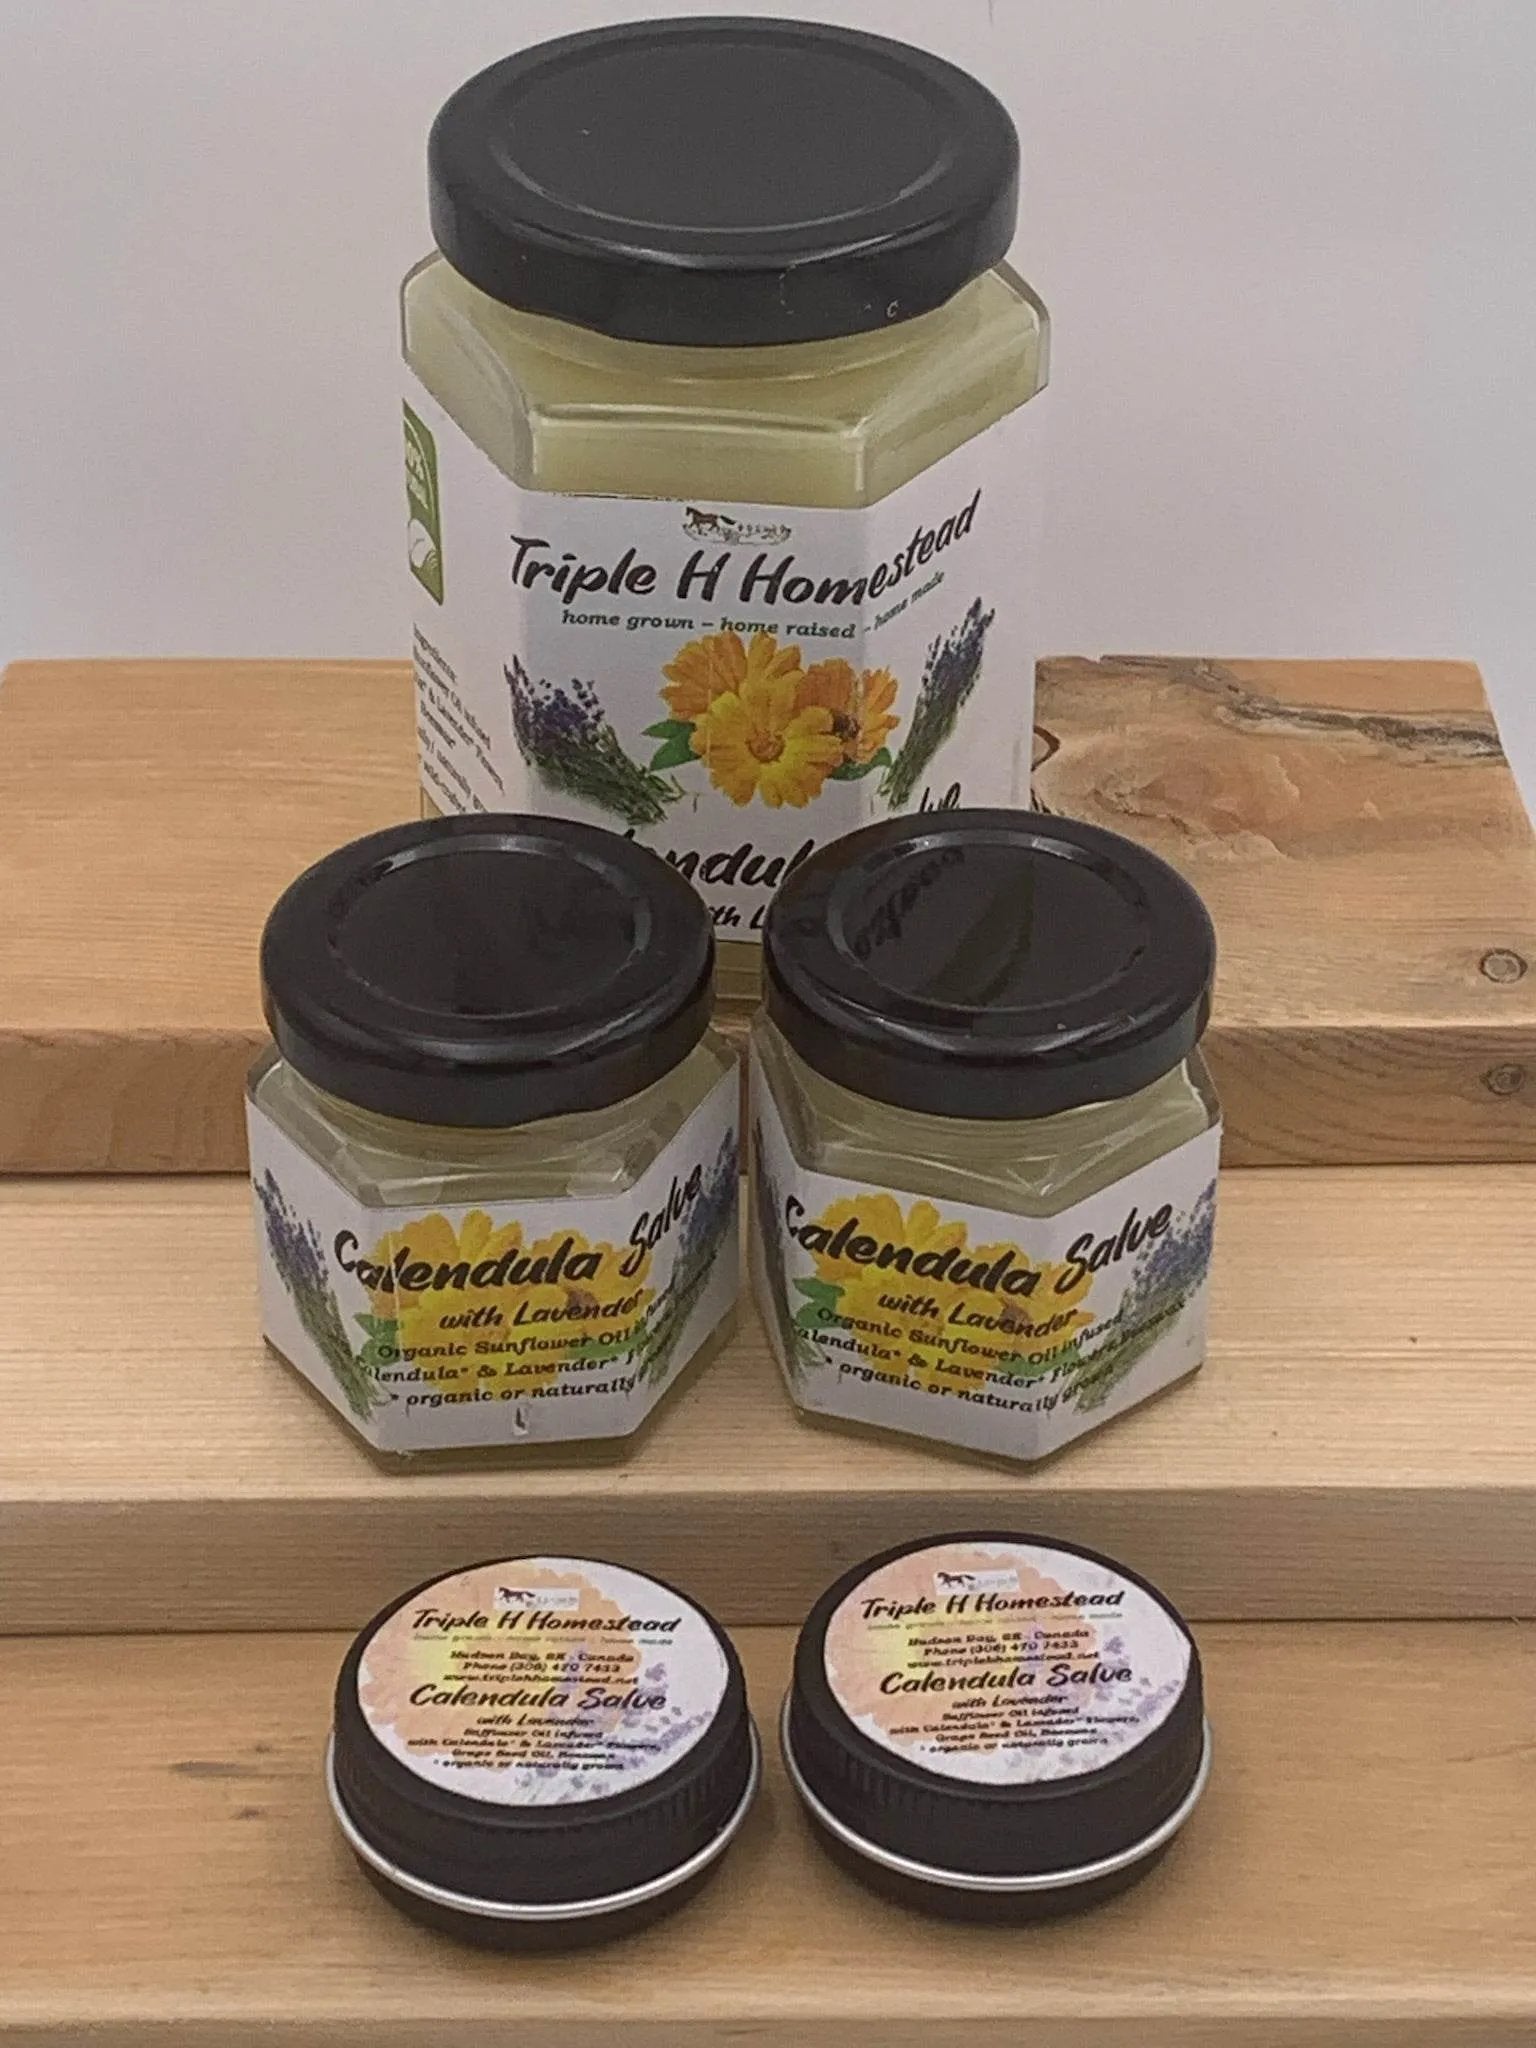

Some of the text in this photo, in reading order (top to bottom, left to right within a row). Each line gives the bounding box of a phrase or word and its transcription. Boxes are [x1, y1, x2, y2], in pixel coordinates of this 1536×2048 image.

[510, 487, 981, 605] Triple H Homestead
[562, 609, 619, 626] home
[626, 615, 694, 631] grown
[720, 617, 778, 634] home
[786, 622, 856, 639] raised
[334, 1163, 702, 1293] Calendula Salve
[786, 1195, 1173, 1298] Calendula Salve
[439, 1288, 643, 1330] with Lavender
[878, 1294, 1078, 1338] with Lavender
[377, 1343, 467, 1361] Organic
[474, 1334, 592, 1356] Sunflower
[598, 1328, 630, 1345] Oil
[817, 1307, 903, 1339] Organic
[908, 1328, 1021, 1362] Sunflower
[1028, 1346, 1057, 1365] Oil
[477, 1364, 497, 1378] &
[907, 1353, 928, 1369] &
[406, 1374, 636, 1408] organic or naturally
[840, 1362, 922, 1391] organic
[928, 1384, 952, 1397] or
[957, 1390, 1058, 1412] naturally
[412, 1609, 682, 1632] Triple H Homestead
[861, 1590, 1125, 1620] Triple H Homestead
[463, 1661, 507, 1671] Phone
[924, 1647, 967, 1656] Phone
[880, 1662, 1132, 1694] Calendula Salve
[410, 1684, 667, 1710] Calendula Salve
[952, 1697, 986, 1709] with
